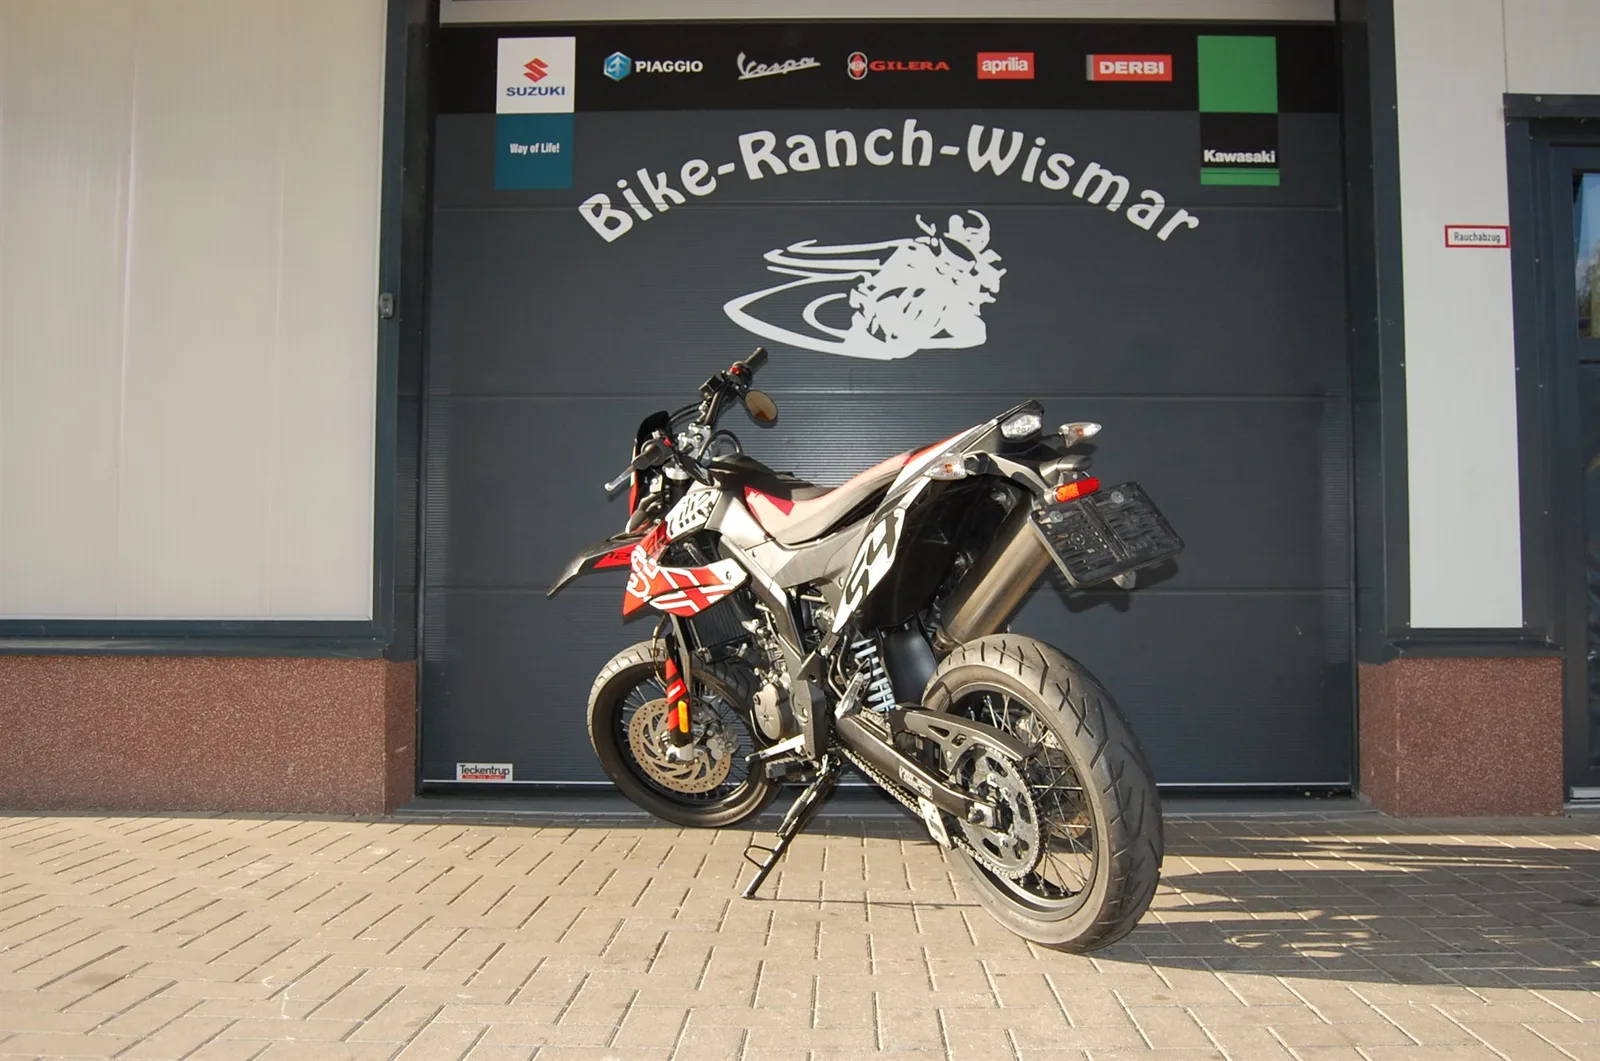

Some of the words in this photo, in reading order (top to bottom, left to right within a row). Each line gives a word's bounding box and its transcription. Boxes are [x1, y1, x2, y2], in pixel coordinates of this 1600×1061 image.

[635, 60, 703, 73] PIAGGIO
[737, 51, 821, 80] Vespa
[869, 60, 950, 72] GILERA
[981, 56, 1029, 76] aprilia
[1099, 61, 1165, 75] DERBI
[506, 86, 566, 97] SUZUKI
[509, 142, 528, 155] Way
[529, 142, 540, 154] of
[540, 141, 560, 154] Life!
[1203, 149, 1276, 164] Kawasaki
[1453, 231, 1501, 244] Rauchabzug
[459, 764, 511, 777] Teckentrup
